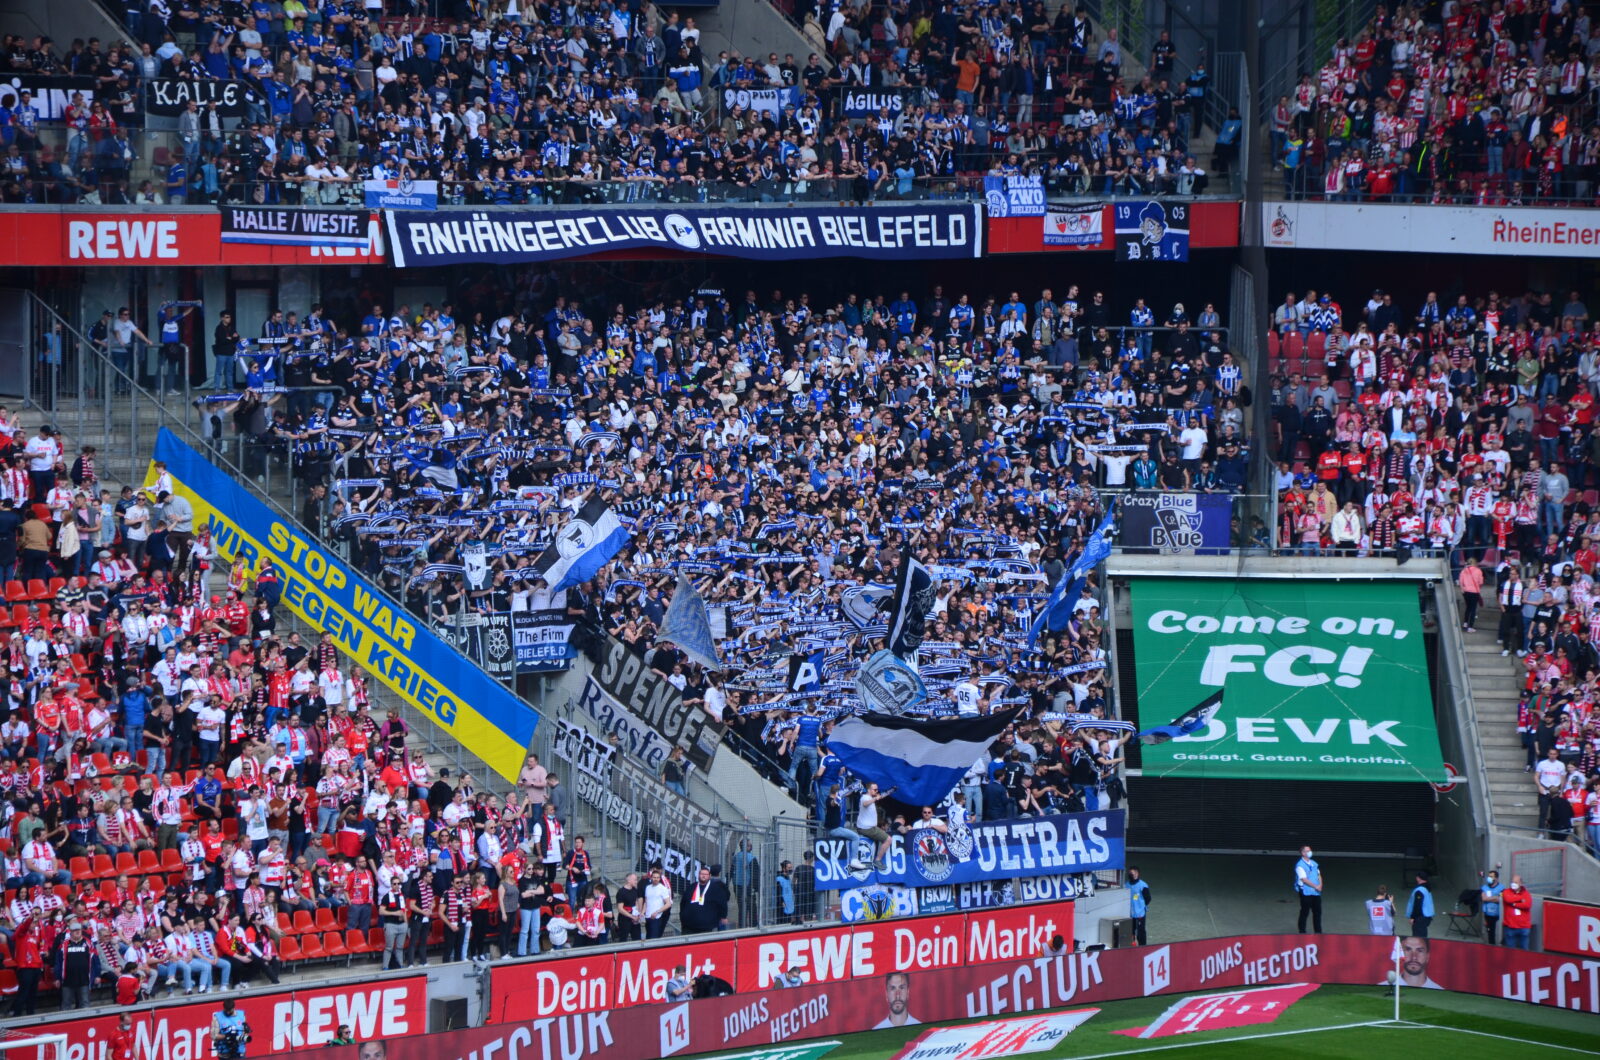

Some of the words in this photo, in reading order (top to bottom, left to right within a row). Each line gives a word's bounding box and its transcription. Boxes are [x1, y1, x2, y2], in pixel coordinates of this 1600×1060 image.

[752, 89, 776, 100] PLUS
[1009, 189, 1043, 205] ZWO
[1118, 205, 1131, 220] 19
[1172, 206, 1185, 220] 05
[69, 221, 179, 259] REWE
[232, 209, 287, 230] HALLE
[302, 213, 360, 235] WESTF.
[408, 213, 667, 255] ANHÄNGERCLUB
[697, 216, 816, 248] ARMINIA
[818, 214, 967, 248] BIELEFELD
[1493, 220, 1600, 245] RheinEner
[1124, 493, 1160, 509] Crazy
[1162, 495, 1193, 508] Blue
[268, 521, 347, 590] STOP
[353, 583, 416, 652] WAR
[208, 511, 258, 571] WIR
[367, 639, 458, 728] KRIEG
[517, 631, 538, 643] The
[541, 628, 564, 640] Firm
[1148, 610, 1310, 636] Come
[1321, 616, 1409, 640] on,
[1200, 644, 1374, 689] FC!
[602, 643, 706, 753] SPENGE
[958, 690, 971, 702] 05
[578, 677, 692, 774] Raesfe
[1171, 717, 1408, 747] DEVK
[1172, 753, 1244, 763] Gesagt.
[1250, 754, 1312, 763] Getan.
[1319, 755, 1412, 766] Geholfen.
[816, 841, 847, 882] SK
[975, 817, 1110, 872] ULTRAS
[960, 883, 992, 909] 647
[1022, 874, 1079, 901] BOYS
[758, 931, 873, 989] REWE
[895, 925, 958, 971] Dein
[969, 915, 1056, 964] Markt
[1200, 942, 1243, 983] JONAS
[1244, 944, 1319, 984] HECTOR
[537, 967, 606, 1015] Dein
[618, 953, 715, 1003] Makt
[1148, 959, 1167, 986] 14
[132, 1019, 216, 1060] Mar
[272, 987, 408, 1049] REWE
[474, 1010, 614, 1060] CTOR
[665, 1010, 686, 1047] 14
[724, 998, 769, 1043] JONAS
[770, 993, 829, 1044] HECTOR
